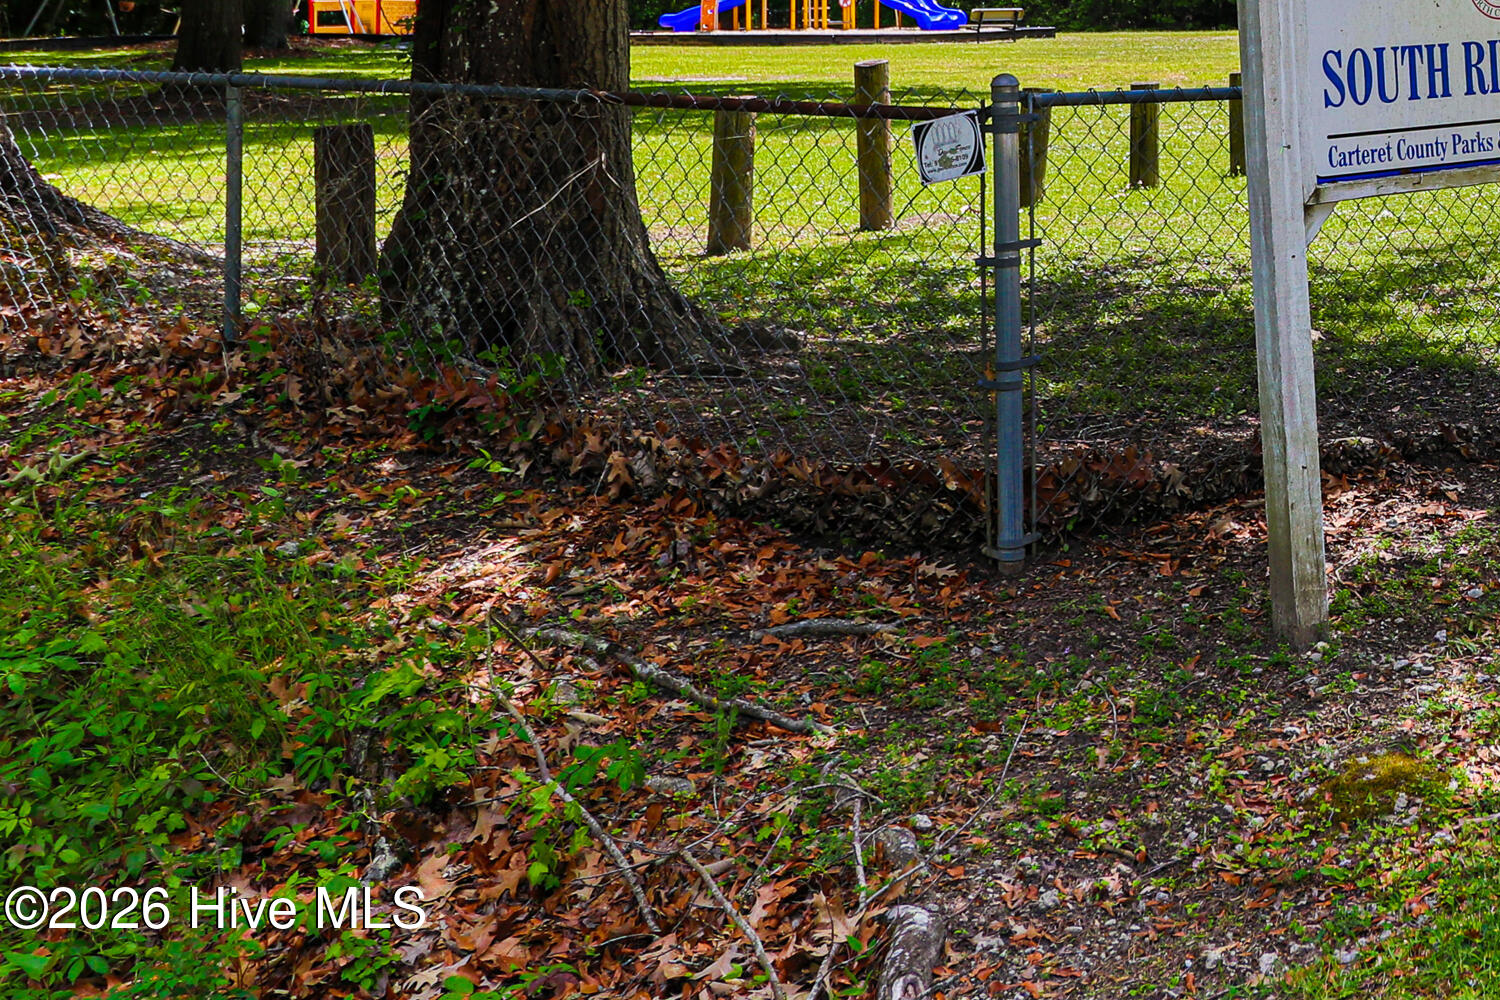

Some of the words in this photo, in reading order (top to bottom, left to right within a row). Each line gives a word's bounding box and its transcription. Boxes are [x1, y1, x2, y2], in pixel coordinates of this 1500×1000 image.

[1322, 43, 1452, 108] SOUTH
[1328, 142, 1393, 168] Carteret
[1397, 136, 1448, 161] County
[1452, 131, 1493, 155] Parks
